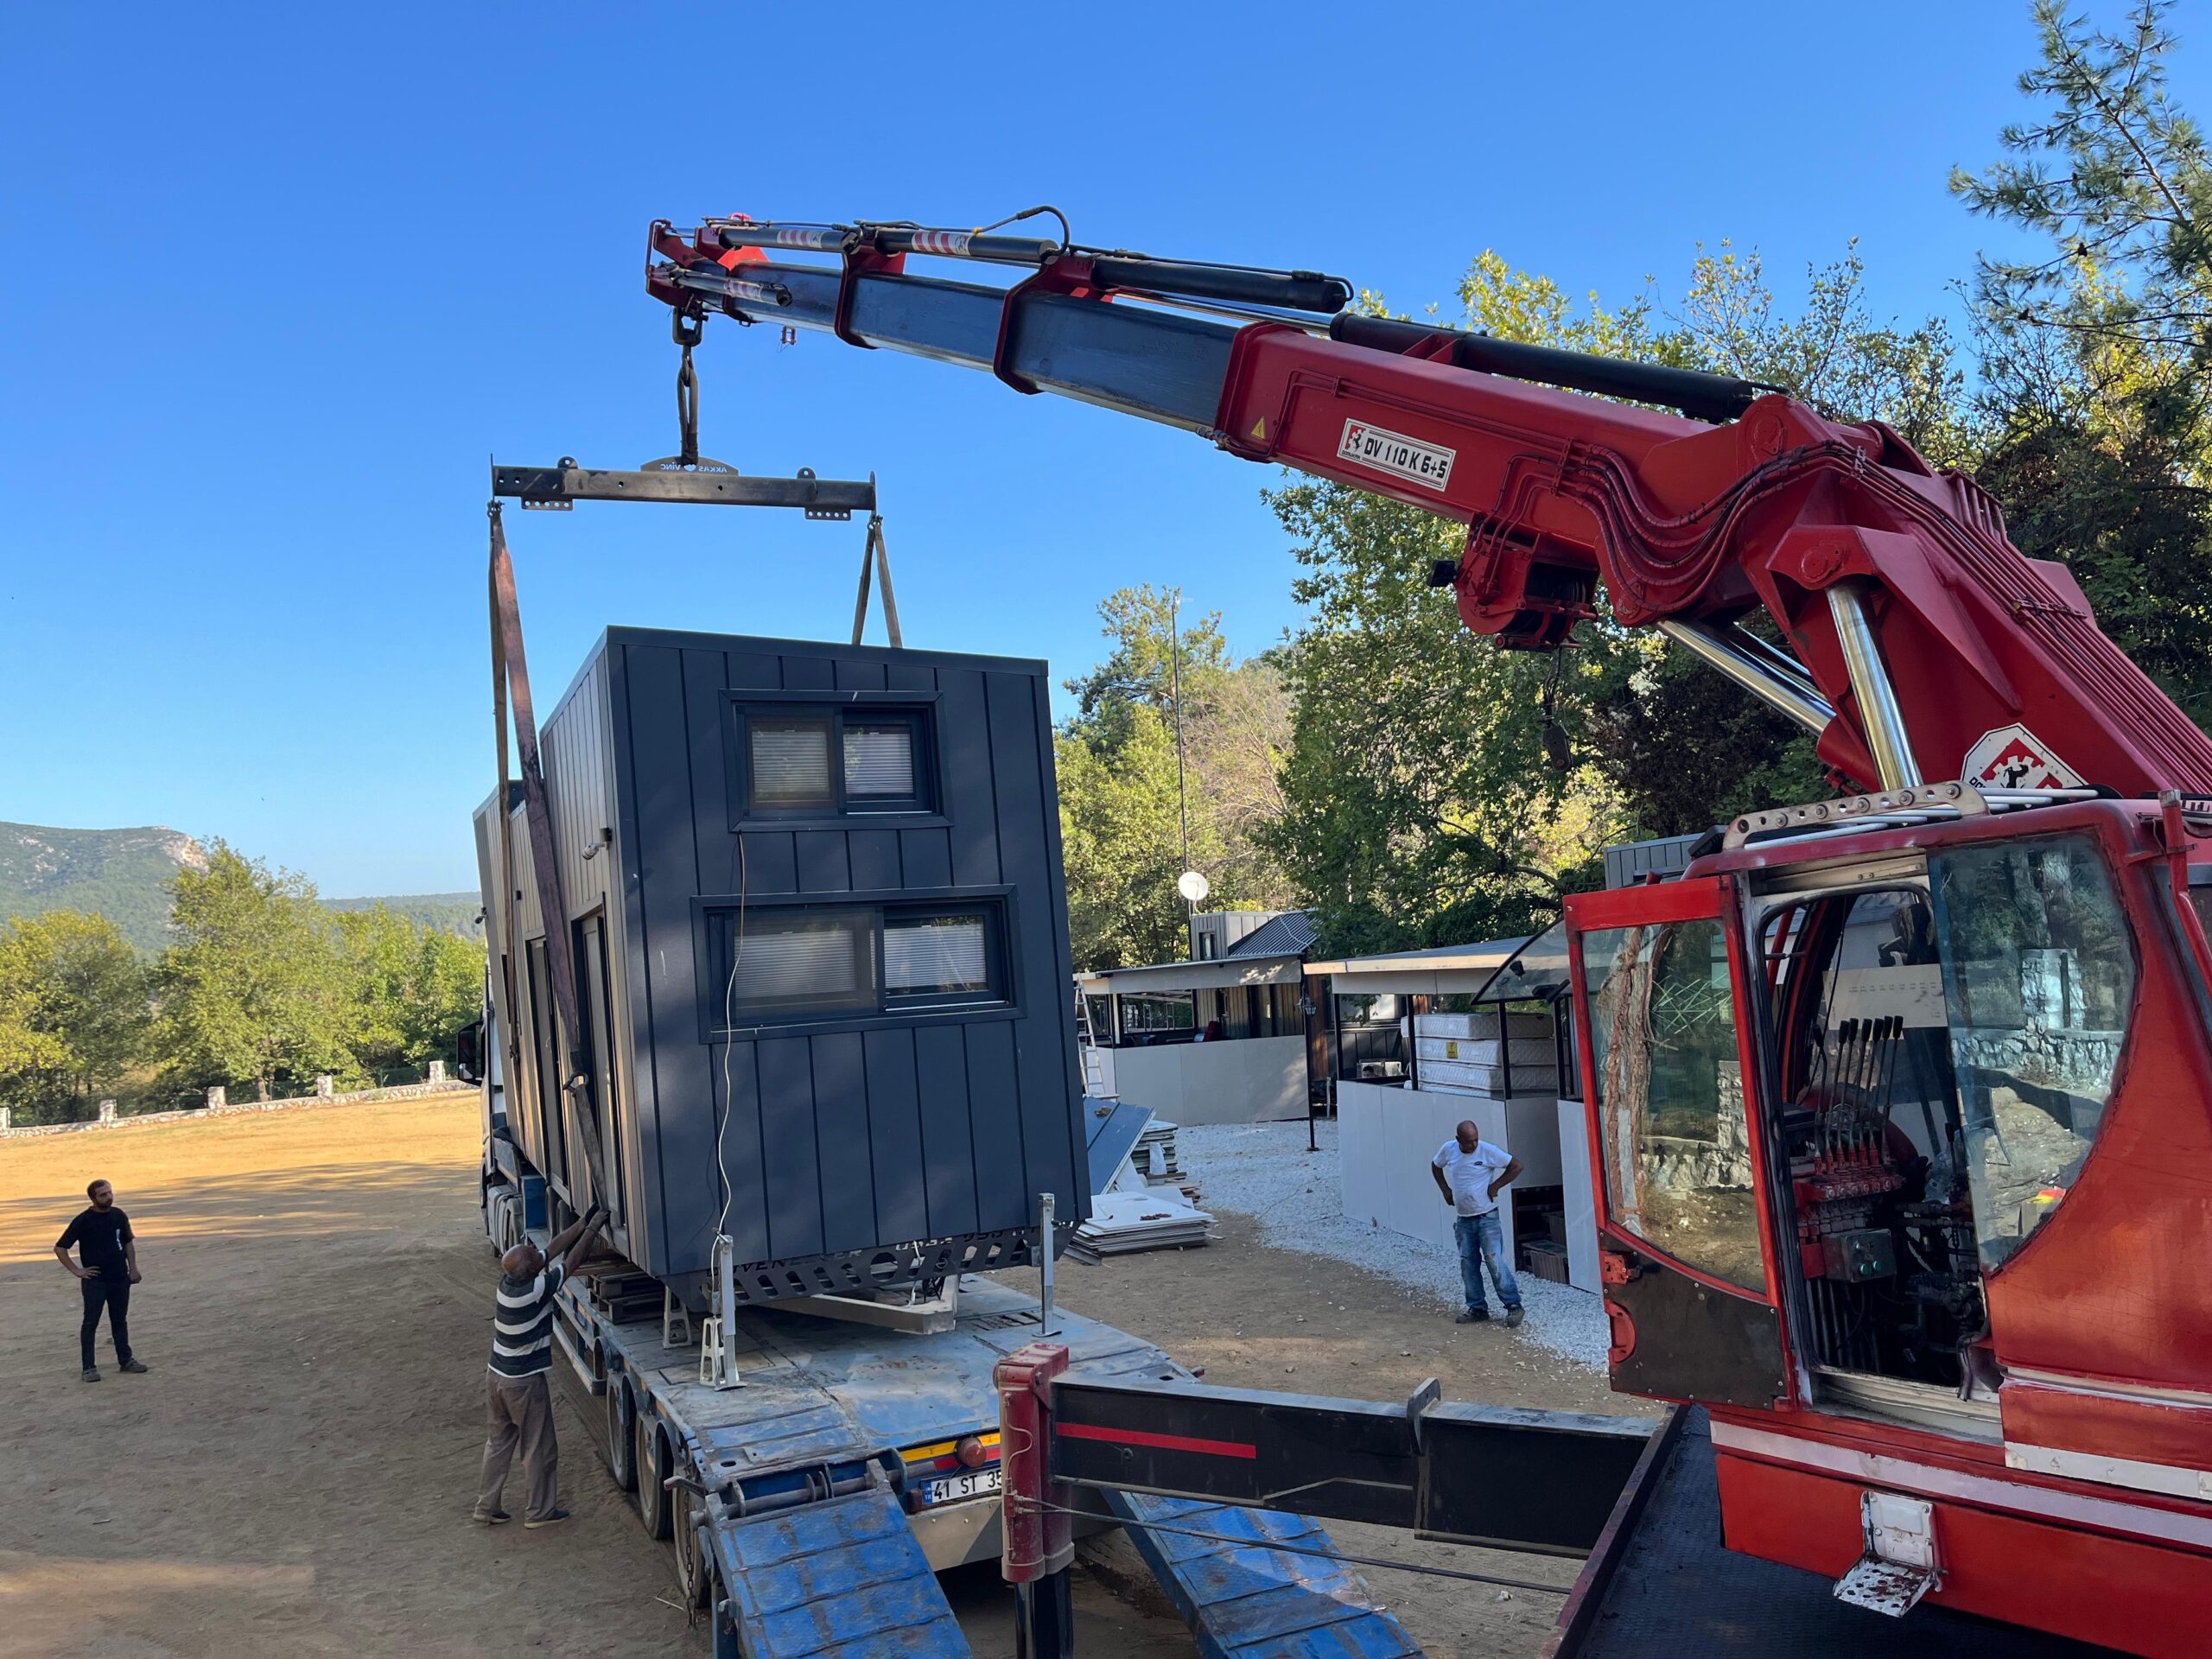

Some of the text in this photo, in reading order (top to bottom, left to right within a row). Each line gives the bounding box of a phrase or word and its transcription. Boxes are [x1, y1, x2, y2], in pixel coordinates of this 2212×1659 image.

[1364, 437, 1448, 479] DV 110 K 6+5
[934, 1480, 950, 1499] 41
[960, 1474, 977, 1495] ST
